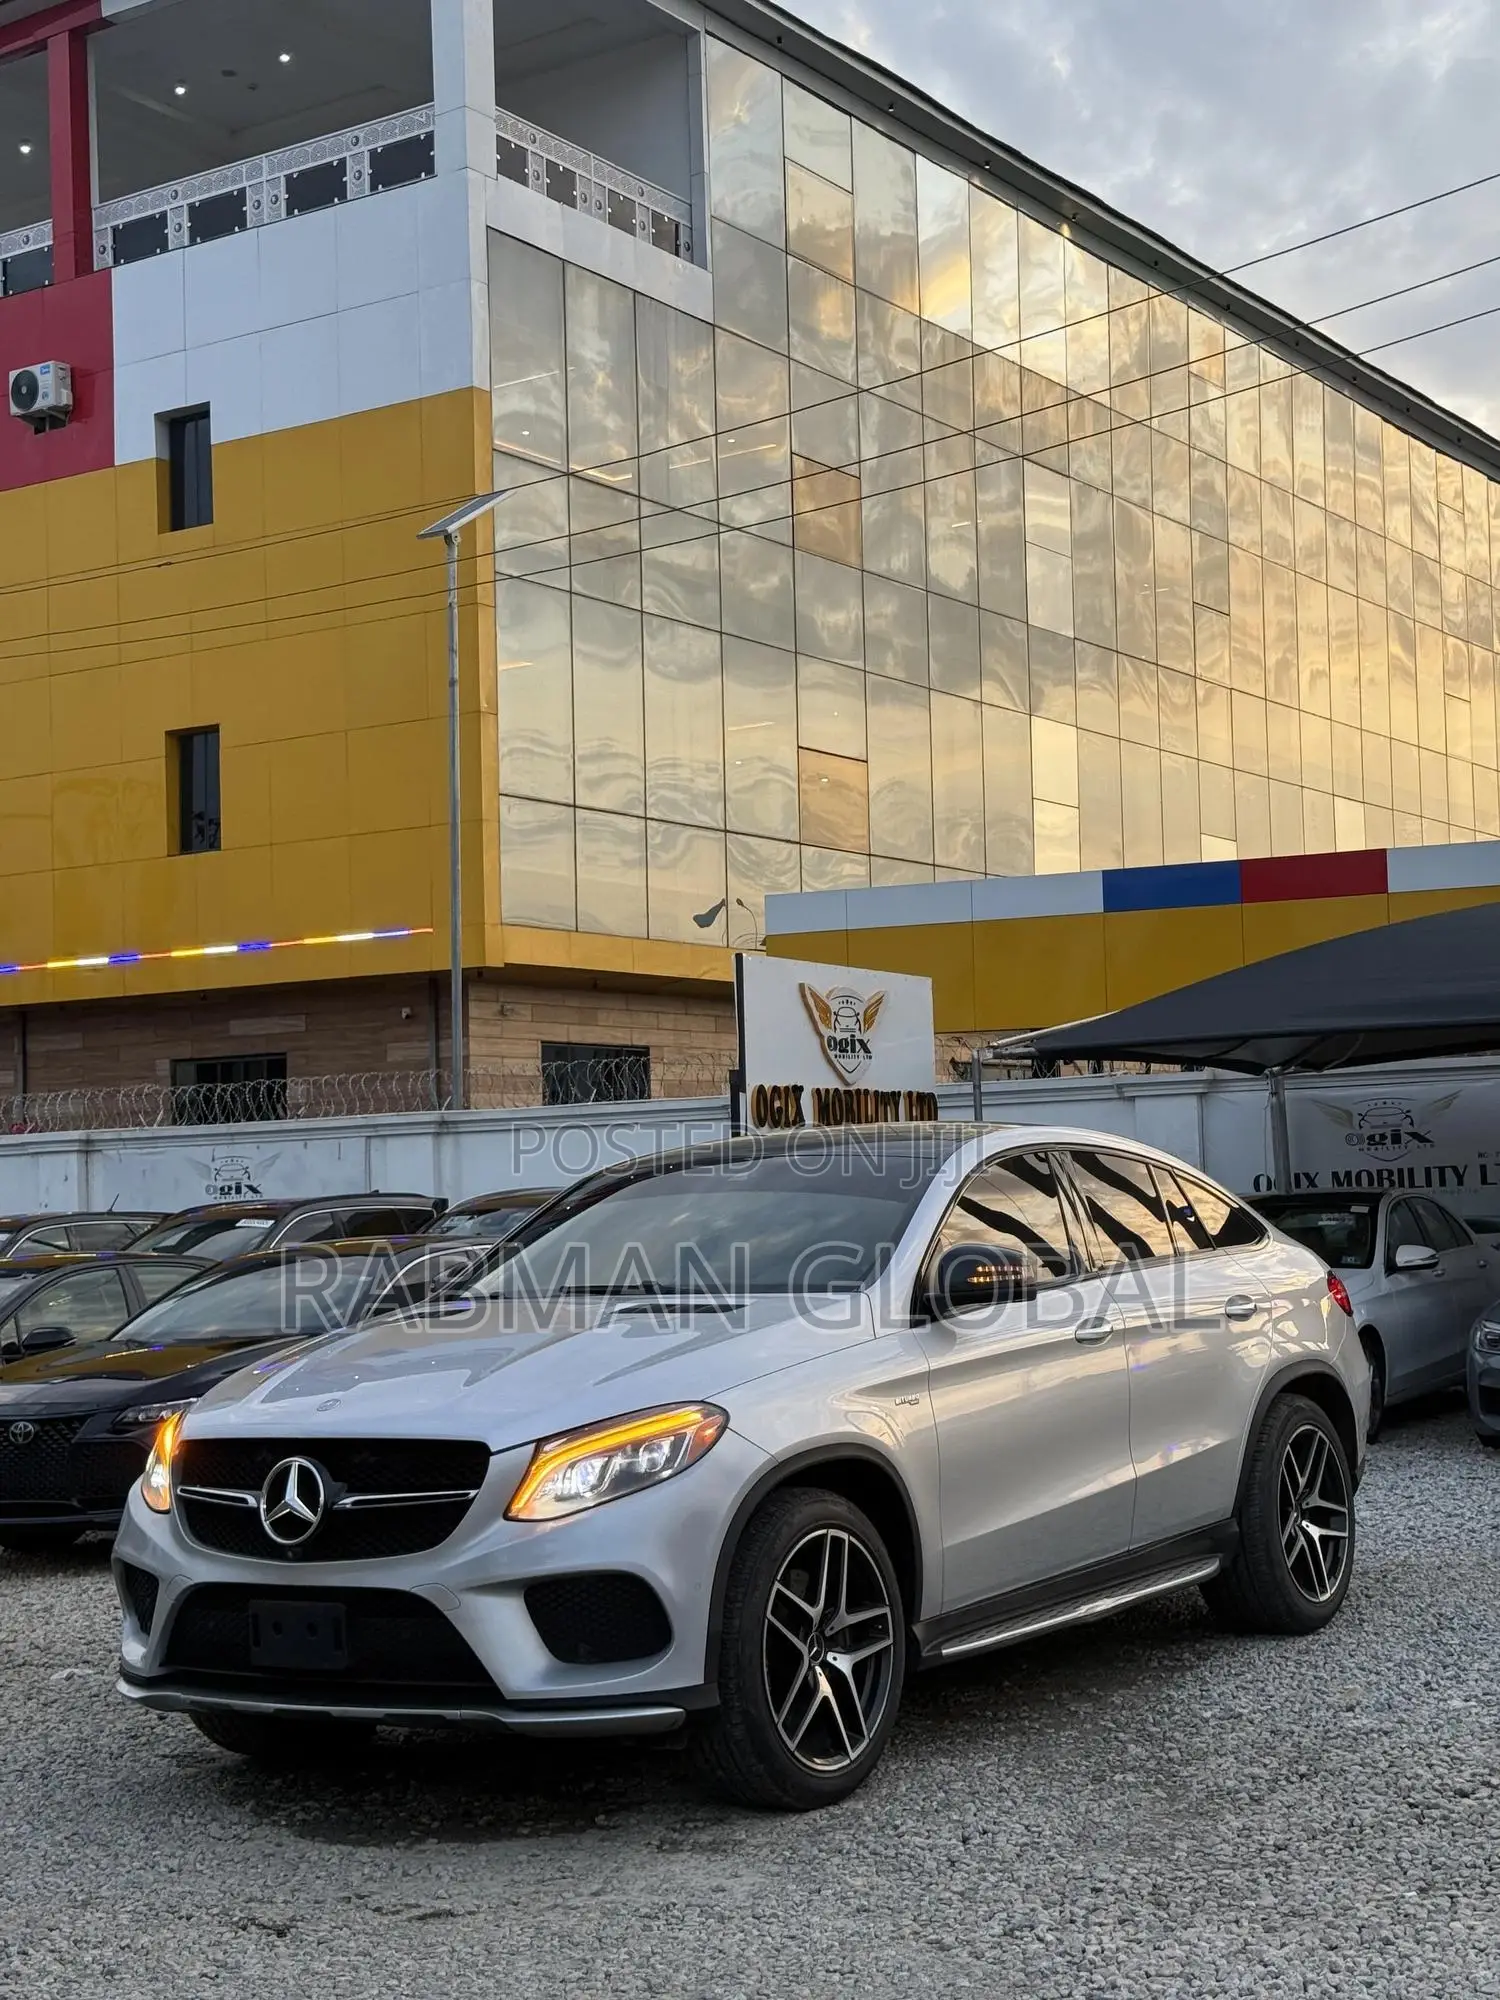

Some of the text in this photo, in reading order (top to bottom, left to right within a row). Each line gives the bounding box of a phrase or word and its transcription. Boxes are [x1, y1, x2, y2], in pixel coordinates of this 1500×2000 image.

[751, 1084, 939, 1129] OGIX MOBILITY LTD
[1253, 1170, 1320, 1193] OIX
[1331, 1165, 1468, 1189] MOBILITY
